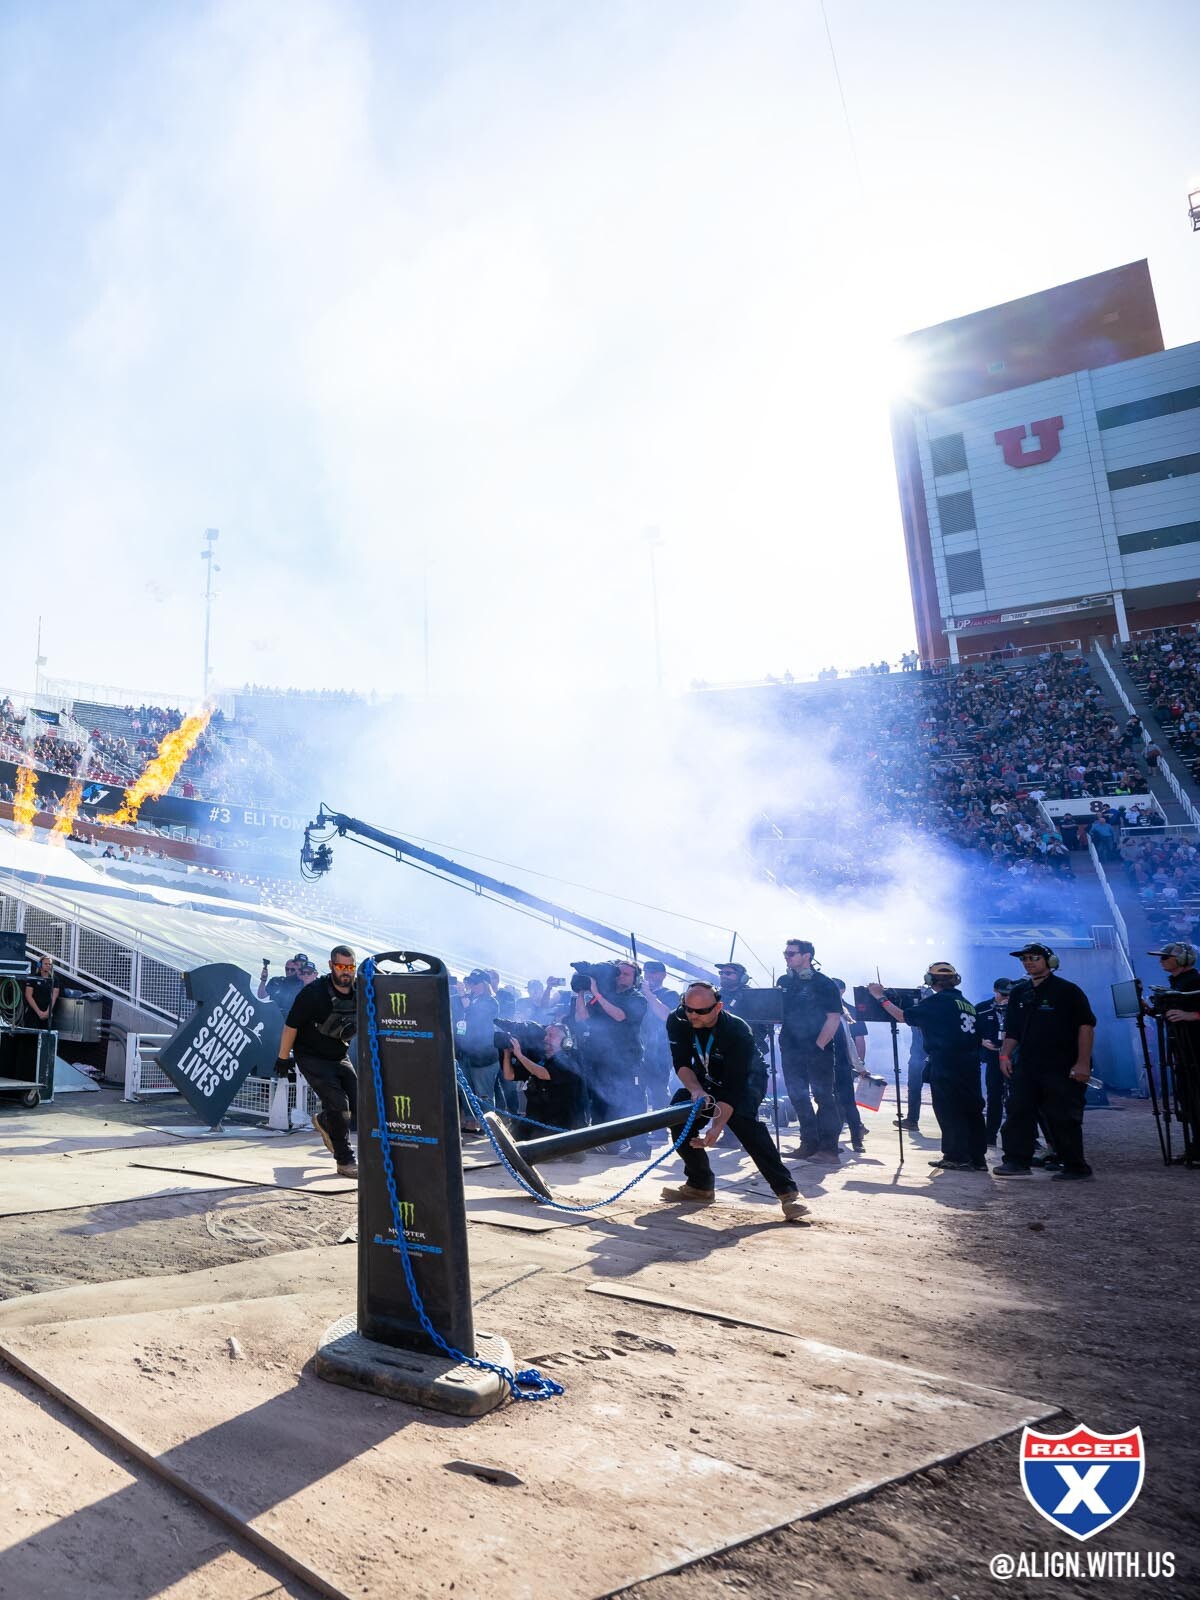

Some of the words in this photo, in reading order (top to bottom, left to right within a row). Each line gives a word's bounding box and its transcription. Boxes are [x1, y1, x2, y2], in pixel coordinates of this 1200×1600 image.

[994, 415, 1065, 469] U
[209, 806, 231, 824] #3
[244, 811, 266, 826] ELI
[221, 983, 255, 1027] THIS
[381, 1018, 418, 1026] MONSTER
[193, 1027, 240, 1081] SAVES
[207, 1006, 252, 1057] SHIRT
[176, 1046, 221, 1097] LIVES
